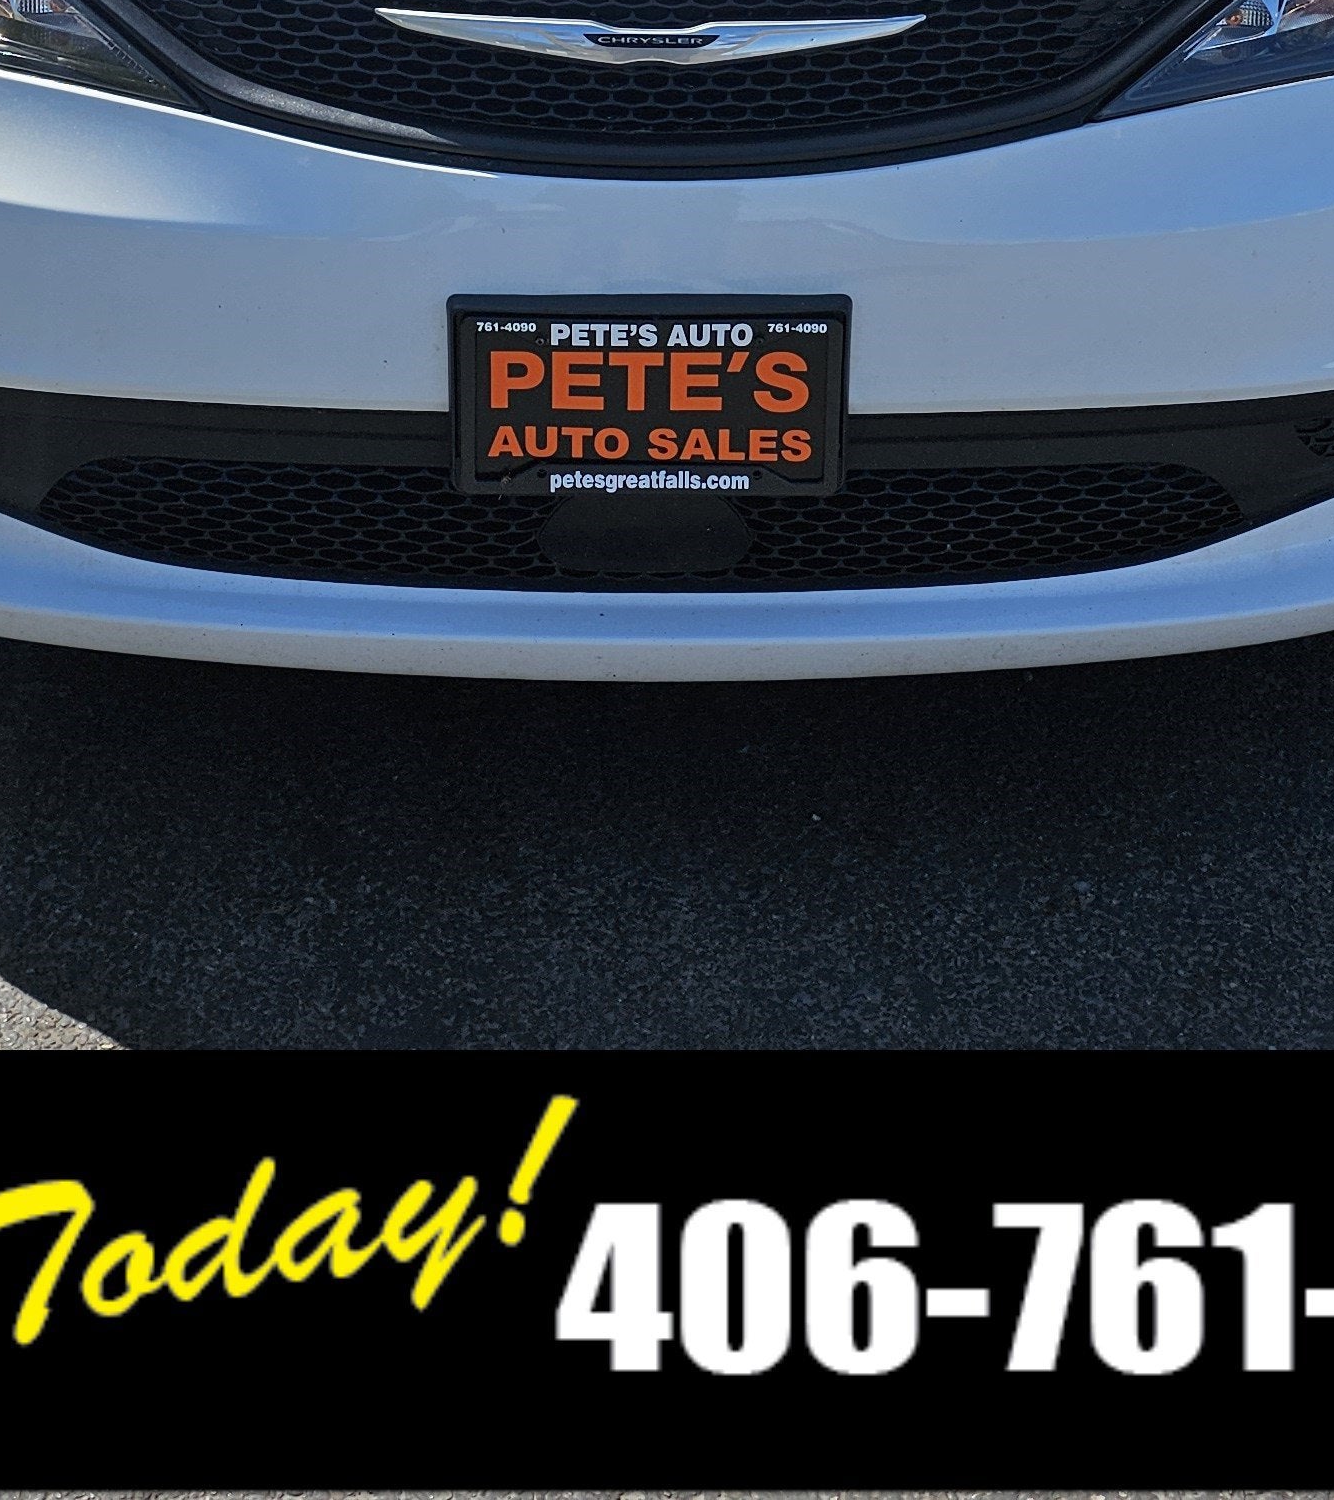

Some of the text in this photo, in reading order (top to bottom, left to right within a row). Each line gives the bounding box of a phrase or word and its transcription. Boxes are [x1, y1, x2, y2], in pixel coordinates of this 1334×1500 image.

[597, 36, 703, 45] CHRYSLER
[476, 321, 537, 333] 761-4090
[550, 323, 754, 347] PETE'S AUTO
[767, 323, 828, 334] PETE'S
[490, 350, 810, 413] PETE'S
[488, 425, 812, 462] AUTO SALES
[550, 470, 750, 493] petesgreatfalls.com
